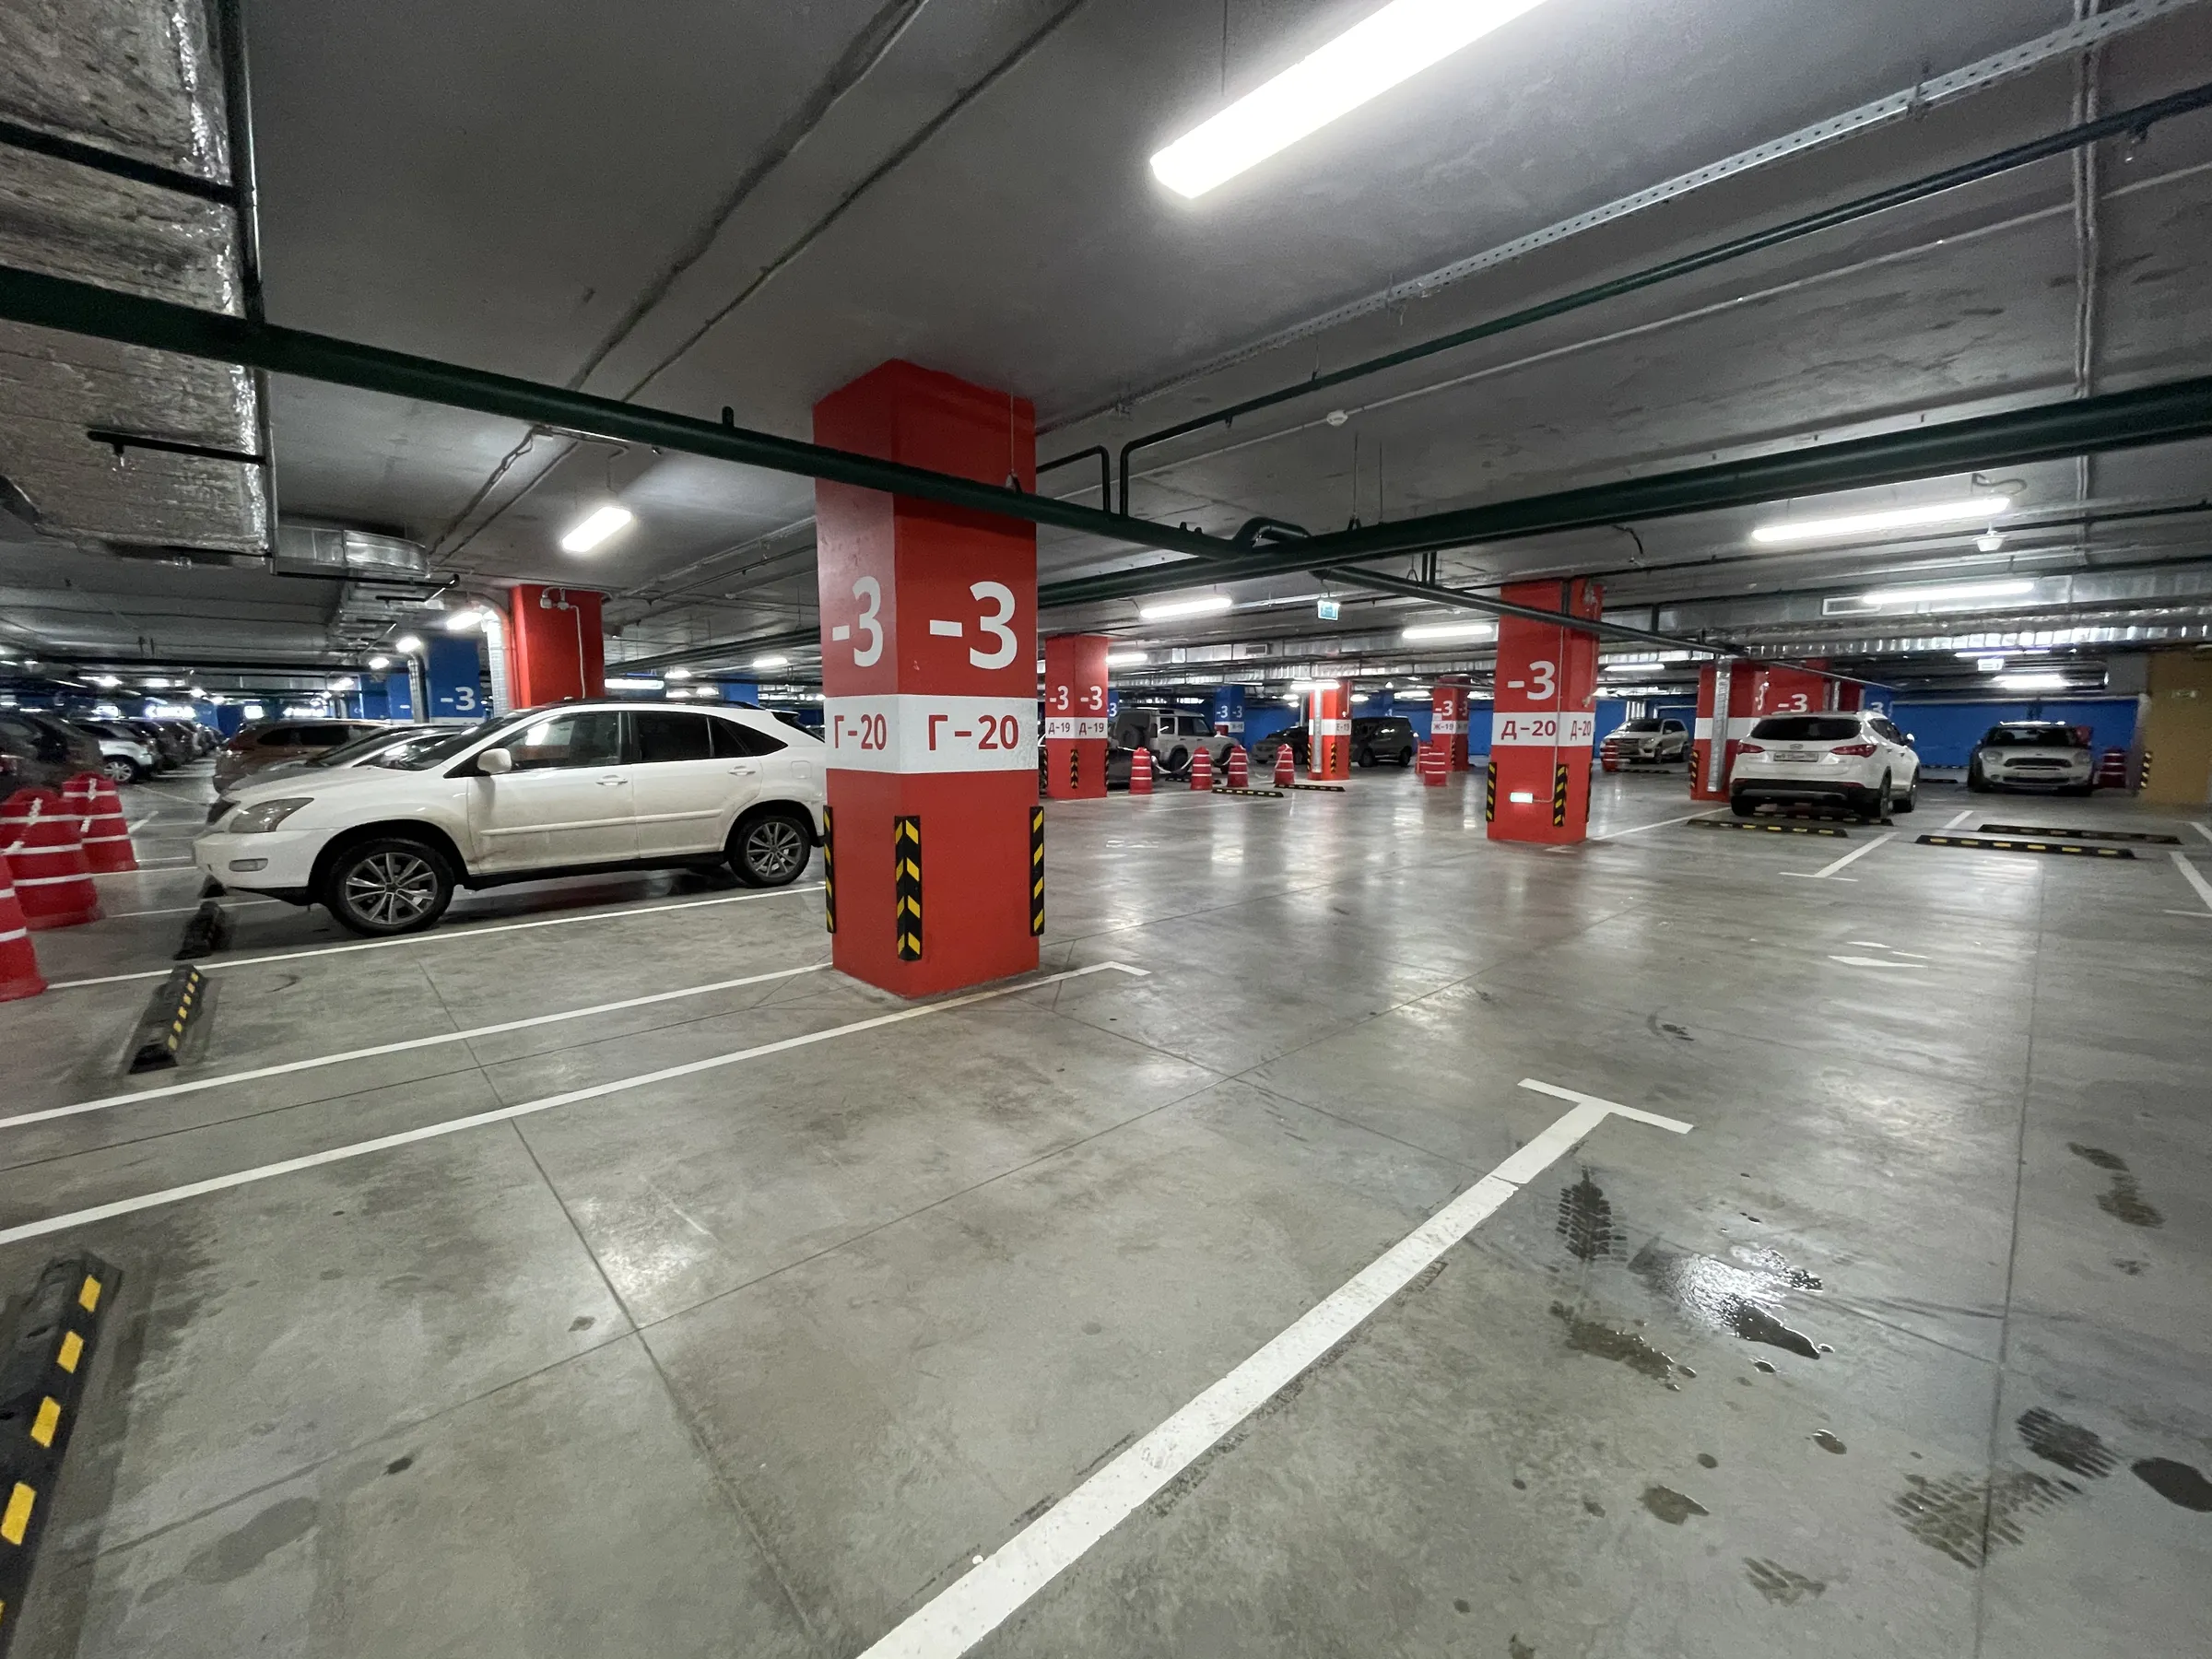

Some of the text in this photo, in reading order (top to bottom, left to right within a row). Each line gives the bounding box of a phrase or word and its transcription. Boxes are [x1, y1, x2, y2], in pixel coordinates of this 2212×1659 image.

[831, 576, 884, 667] -3
[929, 581, 1018, 670] -3
[1507, 660, 1556, 700] -3
[440, 686, 477, 712] -3
[1049, 685, 1069, 711] -3
[1080, 685, 1103, 711] -3
[1434, 700, 1453, 717] -3
[1778, 693, 1808, 713] -3
[1216, 704, 1229, 719] -3
[1231, 704, 1242, 719] -3
[834, 713, 887, 750] Г-20
[928, 714, 1019, 751] Г-20
[1048, 722, 1071, 735] Д-19
[1078, 722, 1104, 736] Д-19
[1500, 720, 1557, 741] Д-20
[1570, 720, 1592, 741] Д-20
